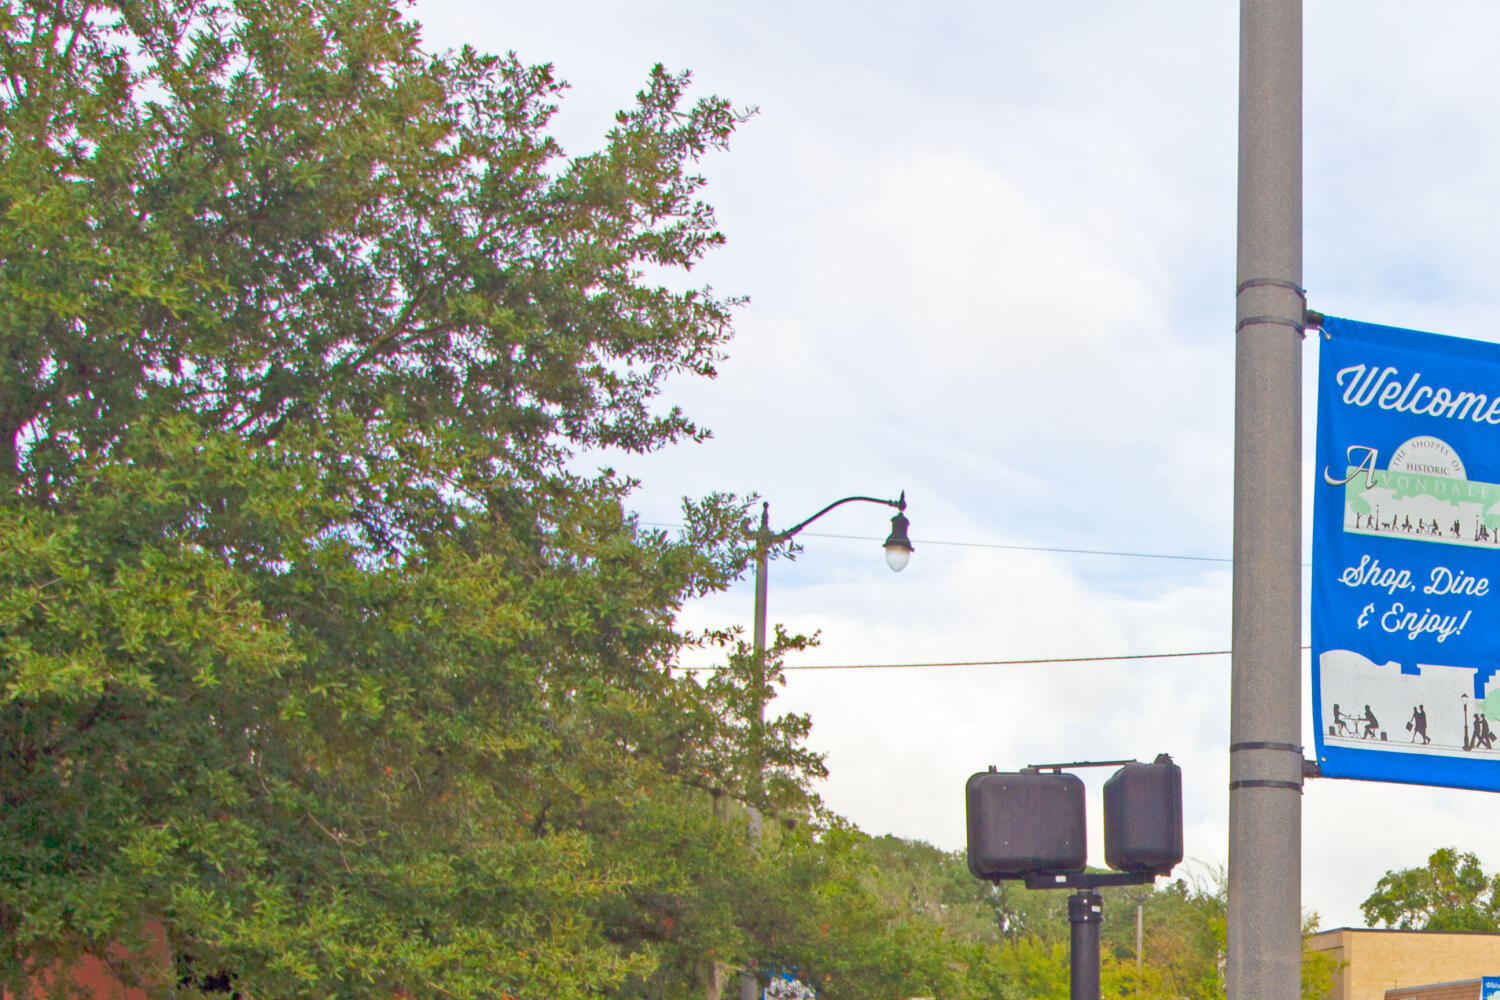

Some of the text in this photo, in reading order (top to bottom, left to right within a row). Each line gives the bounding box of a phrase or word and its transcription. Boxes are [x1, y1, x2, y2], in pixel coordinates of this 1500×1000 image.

[1324, 445, 1490, 499] AVONDALE
[1393, 439, 1462, 472] THE SHOPPES OF
[1406, 463, 1450, 476] HISTORIC
[1337, 554, 1490, 596] Shop, Dine
[1357, 602, 1472, 643] & Enjoy!
